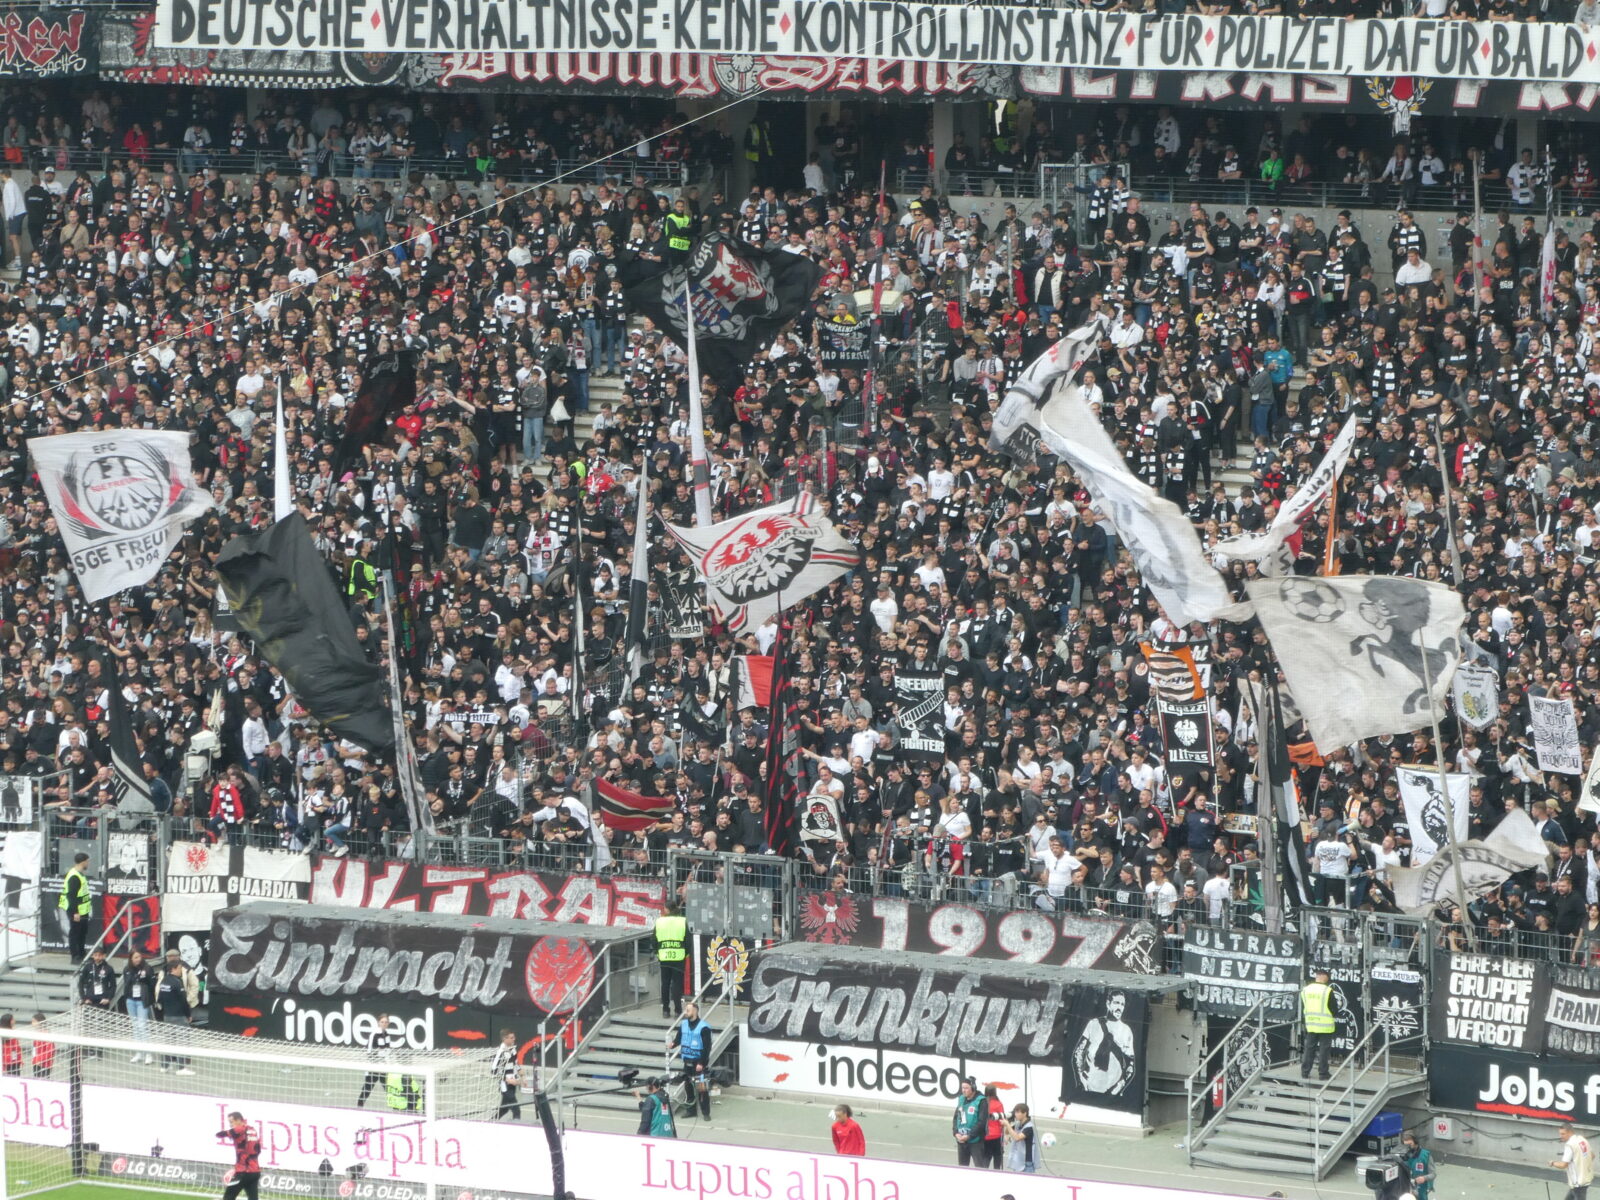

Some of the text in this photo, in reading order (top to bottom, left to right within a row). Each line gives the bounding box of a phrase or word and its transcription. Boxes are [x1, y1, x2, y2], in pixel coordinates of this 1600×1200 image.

[171, 0, 365, 46] DEUTSCHE
[675, 1, 778, 52] KEINE
[794, 2, 1125, 66] KONTROLLINSTANZ
[1138, 15, 1202, 67] FÜR
[1214, 16, 1352, 75] POLIZEI,
[1364, 20, 1479, 75] DAFÜR
[1490, 24, 1584, 78] BALD
[92, 442, 118, 454] EFC
[73, 546, 113, 576] SGE
[1160, 700, 1207, 716] Ragazzi
[900, 738, 945, 754] FIGHTERS
[1169, 749, 1209, 761] Ultras
[167, 875, 299, 899] NUOVA GUARDIA
[310, 857, 667, 930] ULTRAS
[872, 897, 1125, 970] 1997
[1196, 929, 1294, 957] ULTRAS
[214, 912, 512, 1006] Eintracht
[1200, 956, 1285, 983] NEVER
[1450, 954, 1492, 974] EHRE
[1373, 971, 1392, 979] FREE
[1449, 973, 1533, 1004] GRUPPE
[748, 954, 1065, 1056] Frankfurt
[1183, 984, 1295, 1010] SURRENDER
[1447, 997, 1530, 1025] STADION
[1552, 996, 1600, 1026] FRAN
[283, 998, 434, 1051] indeed
[1446, 1017, 1527, 1048] VERBOT
[817, 1044, 967, 1100] indeed
[1479, 1063, 1576, 1112] Jobs
[127, 1162, 197, 1180] LG OLED evo
[260, 1175, 311, 1193] OLED evo
[641, 1143, 900, 1200] Lupus alpha
[355, 1183, 374, 1196] LG
[376, 1184, 413, 1200] OLED
